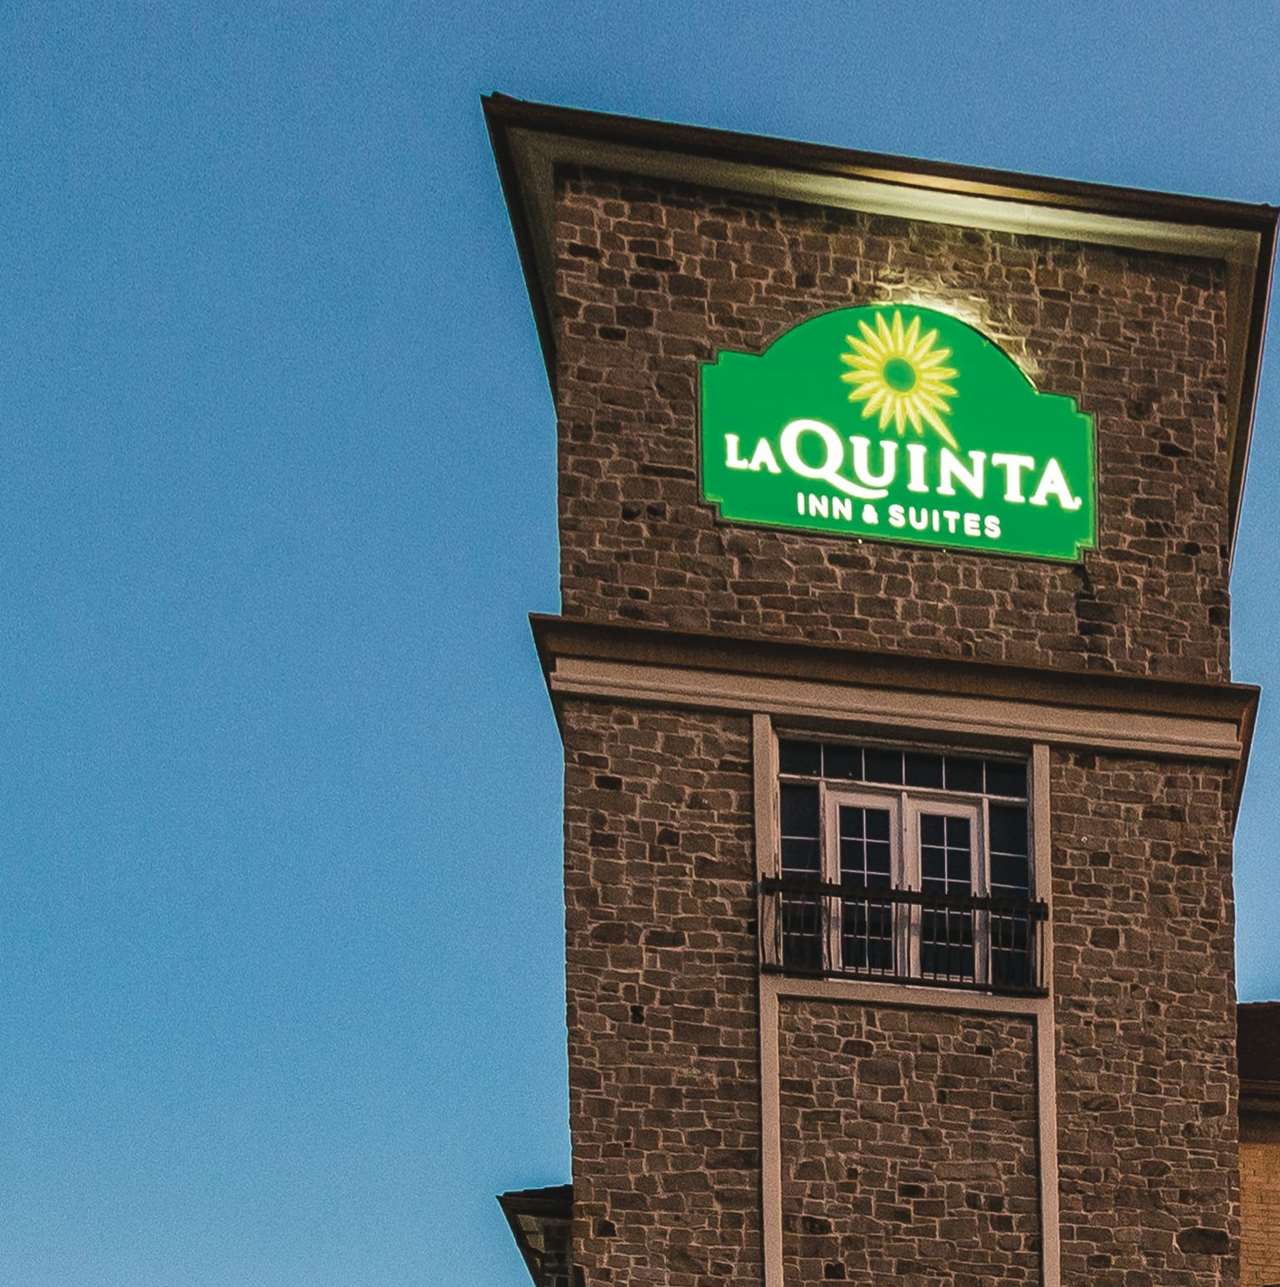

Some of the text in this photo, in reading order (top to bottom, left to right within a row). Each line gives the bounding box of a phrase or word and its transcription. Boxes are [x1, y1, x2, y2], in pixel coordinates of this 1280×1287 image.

[725, 419, 1082, 510] LA QUINTA
[797, 492, 1001, 538] INN & SUITES
